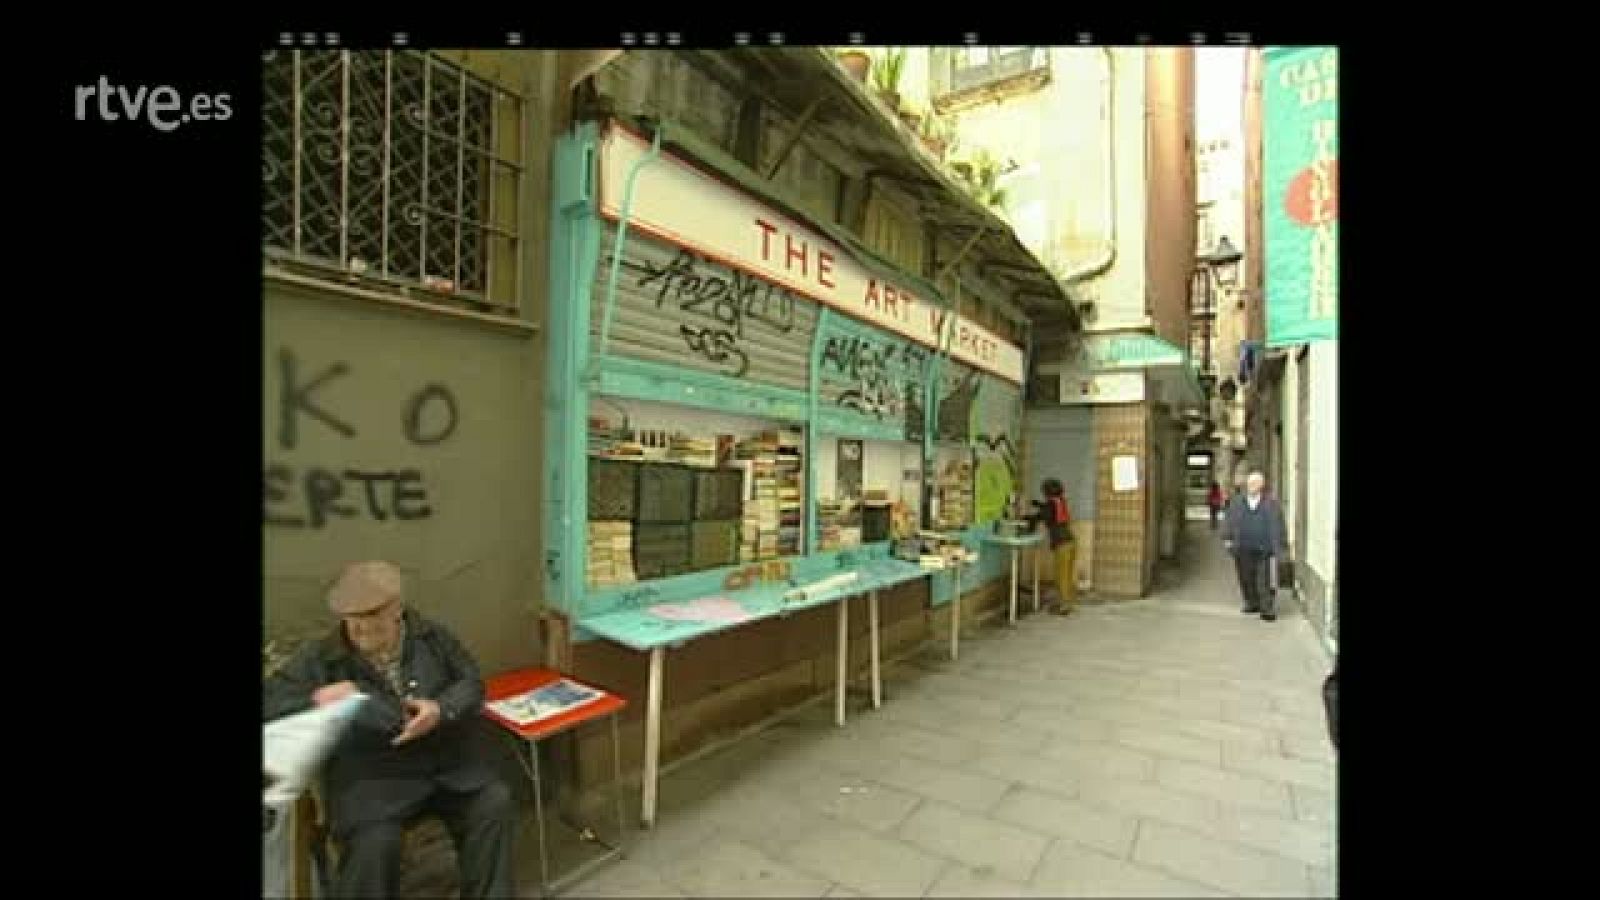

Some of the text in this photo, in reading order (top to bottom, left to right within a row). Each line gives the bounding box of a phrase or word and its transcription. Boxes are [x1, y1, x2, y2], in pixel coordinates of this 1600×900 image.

[754, 217, 836, 289] THE
[863, 278, 916, 322] ART
[928, 307, 1000, 364] MRKET
